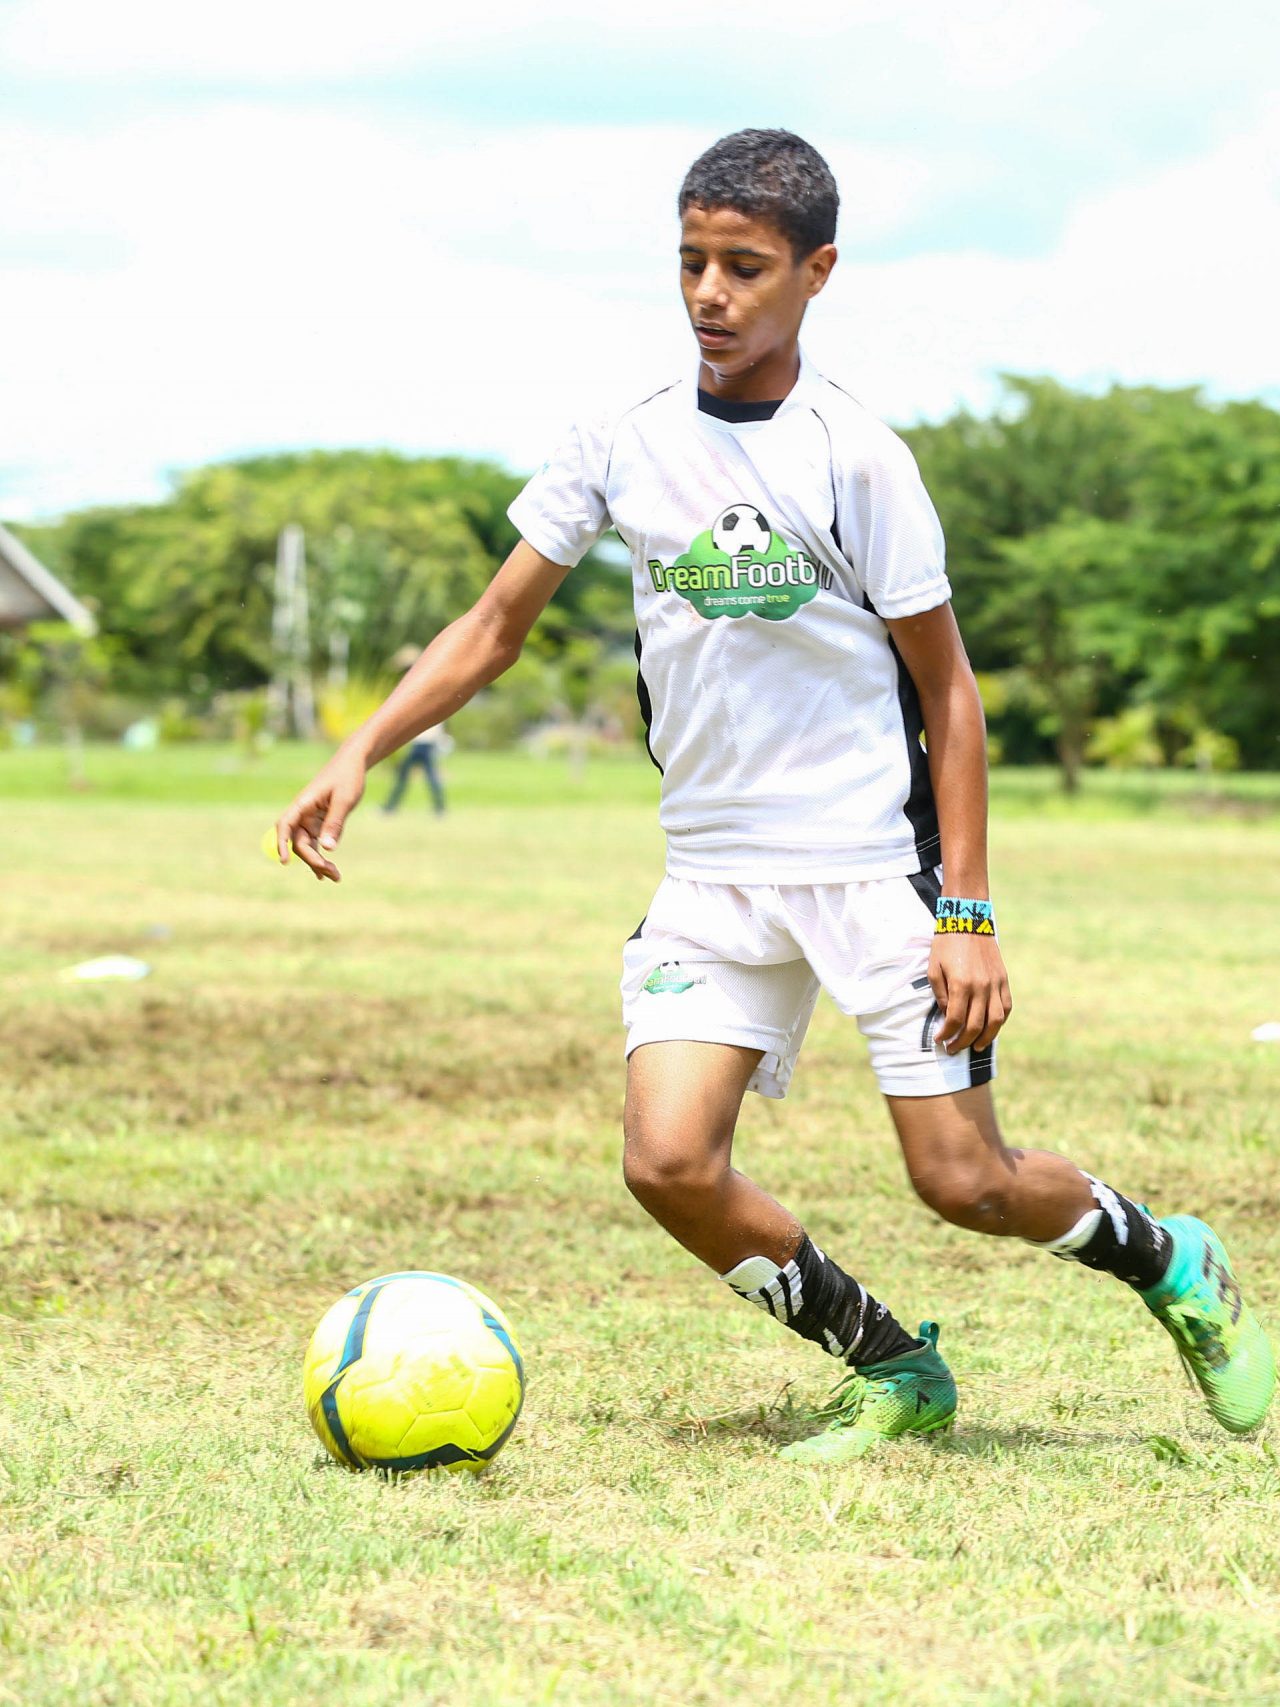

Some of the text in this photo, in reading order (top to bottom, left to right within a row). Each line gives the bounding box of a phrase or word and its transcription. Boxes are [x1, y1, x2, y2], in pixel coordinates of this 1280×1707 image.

[648, 552, 834, 592] DreamFootbll
[704, 594, 790, 606] dreams come true
